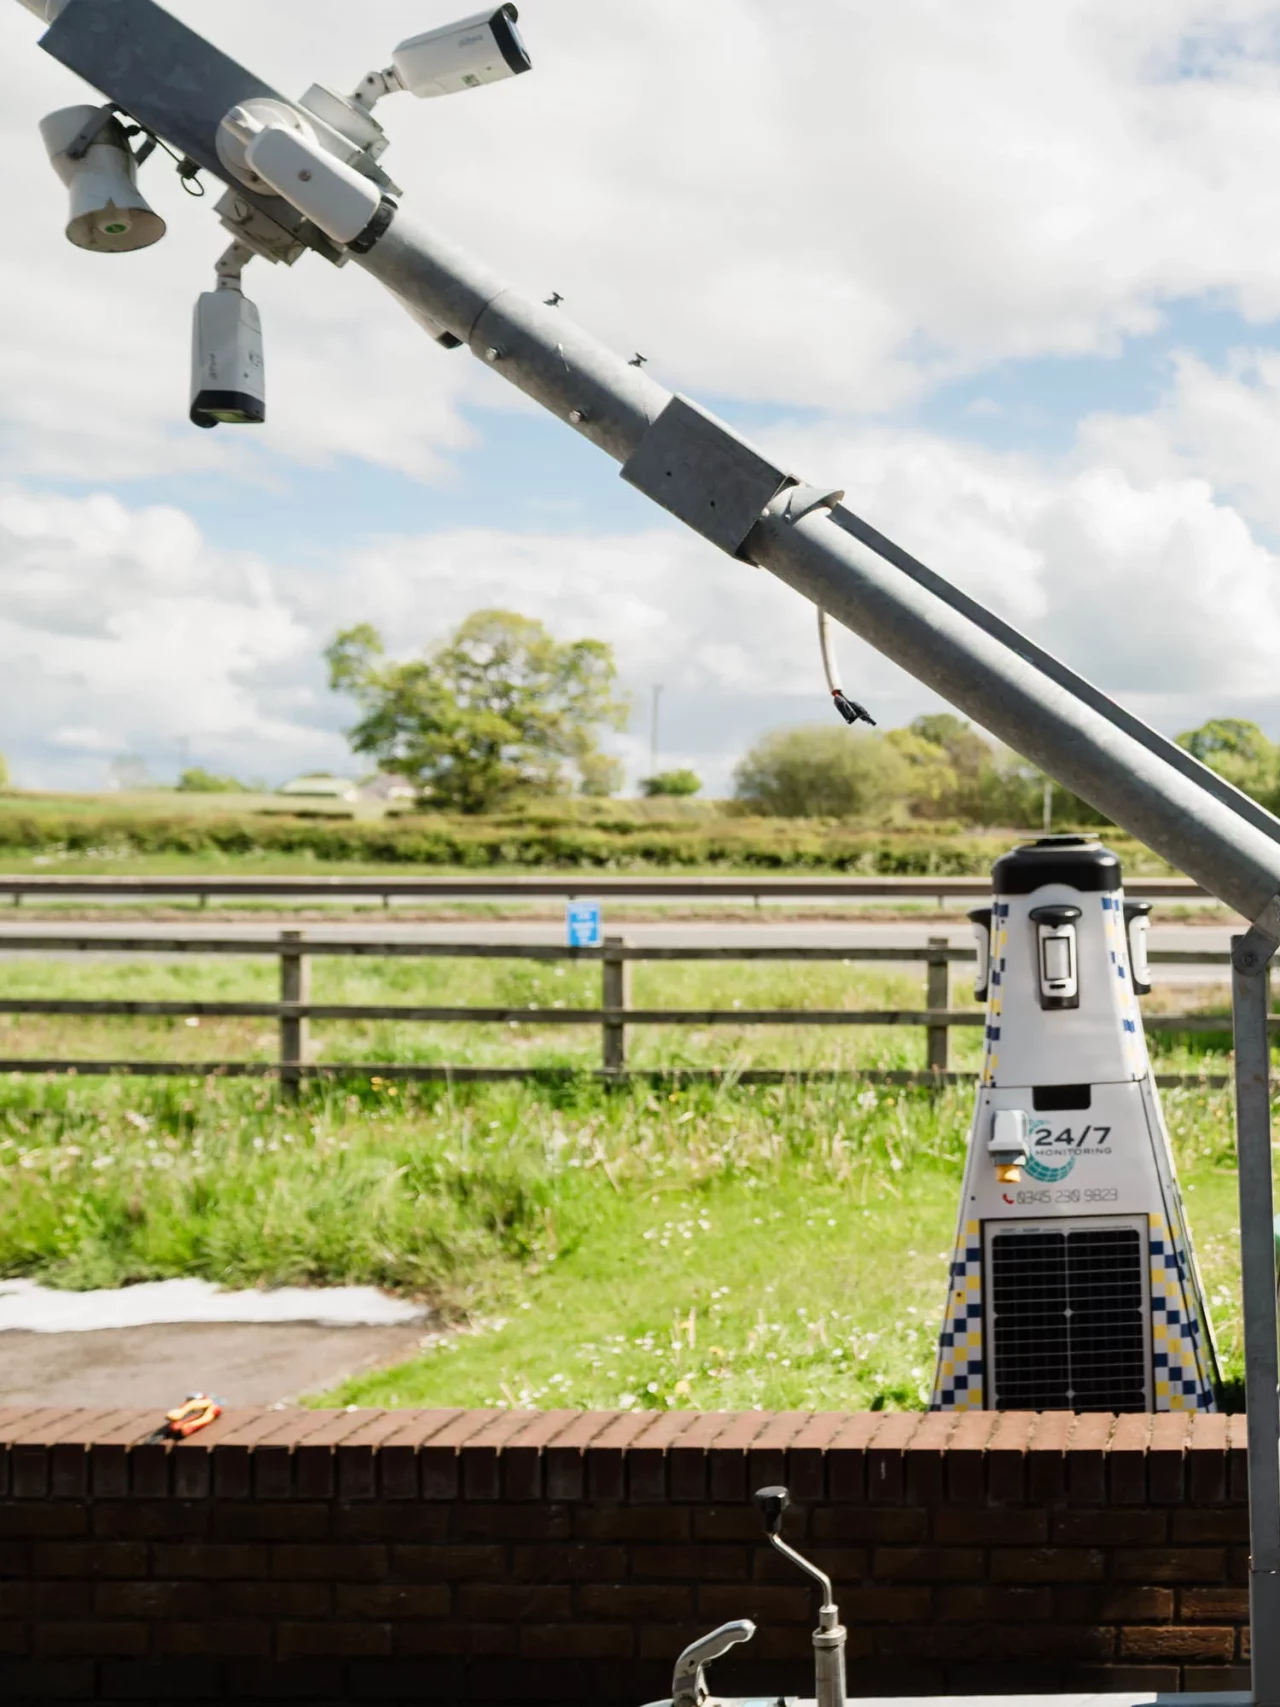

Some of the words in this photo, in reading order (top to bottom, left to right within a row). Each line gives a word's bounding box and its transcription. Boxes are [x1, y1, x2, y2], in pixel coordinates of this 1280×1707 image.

[1035, 1125, 1111, 1147] 24/7
[1035, 1147, 1112, 1156] MONITORING
[1016, 1191, 1051, 1205] 0345
[1055, 1189, 1081, 1203] 230
[1084, 1188, 1118, 1202] 9823
